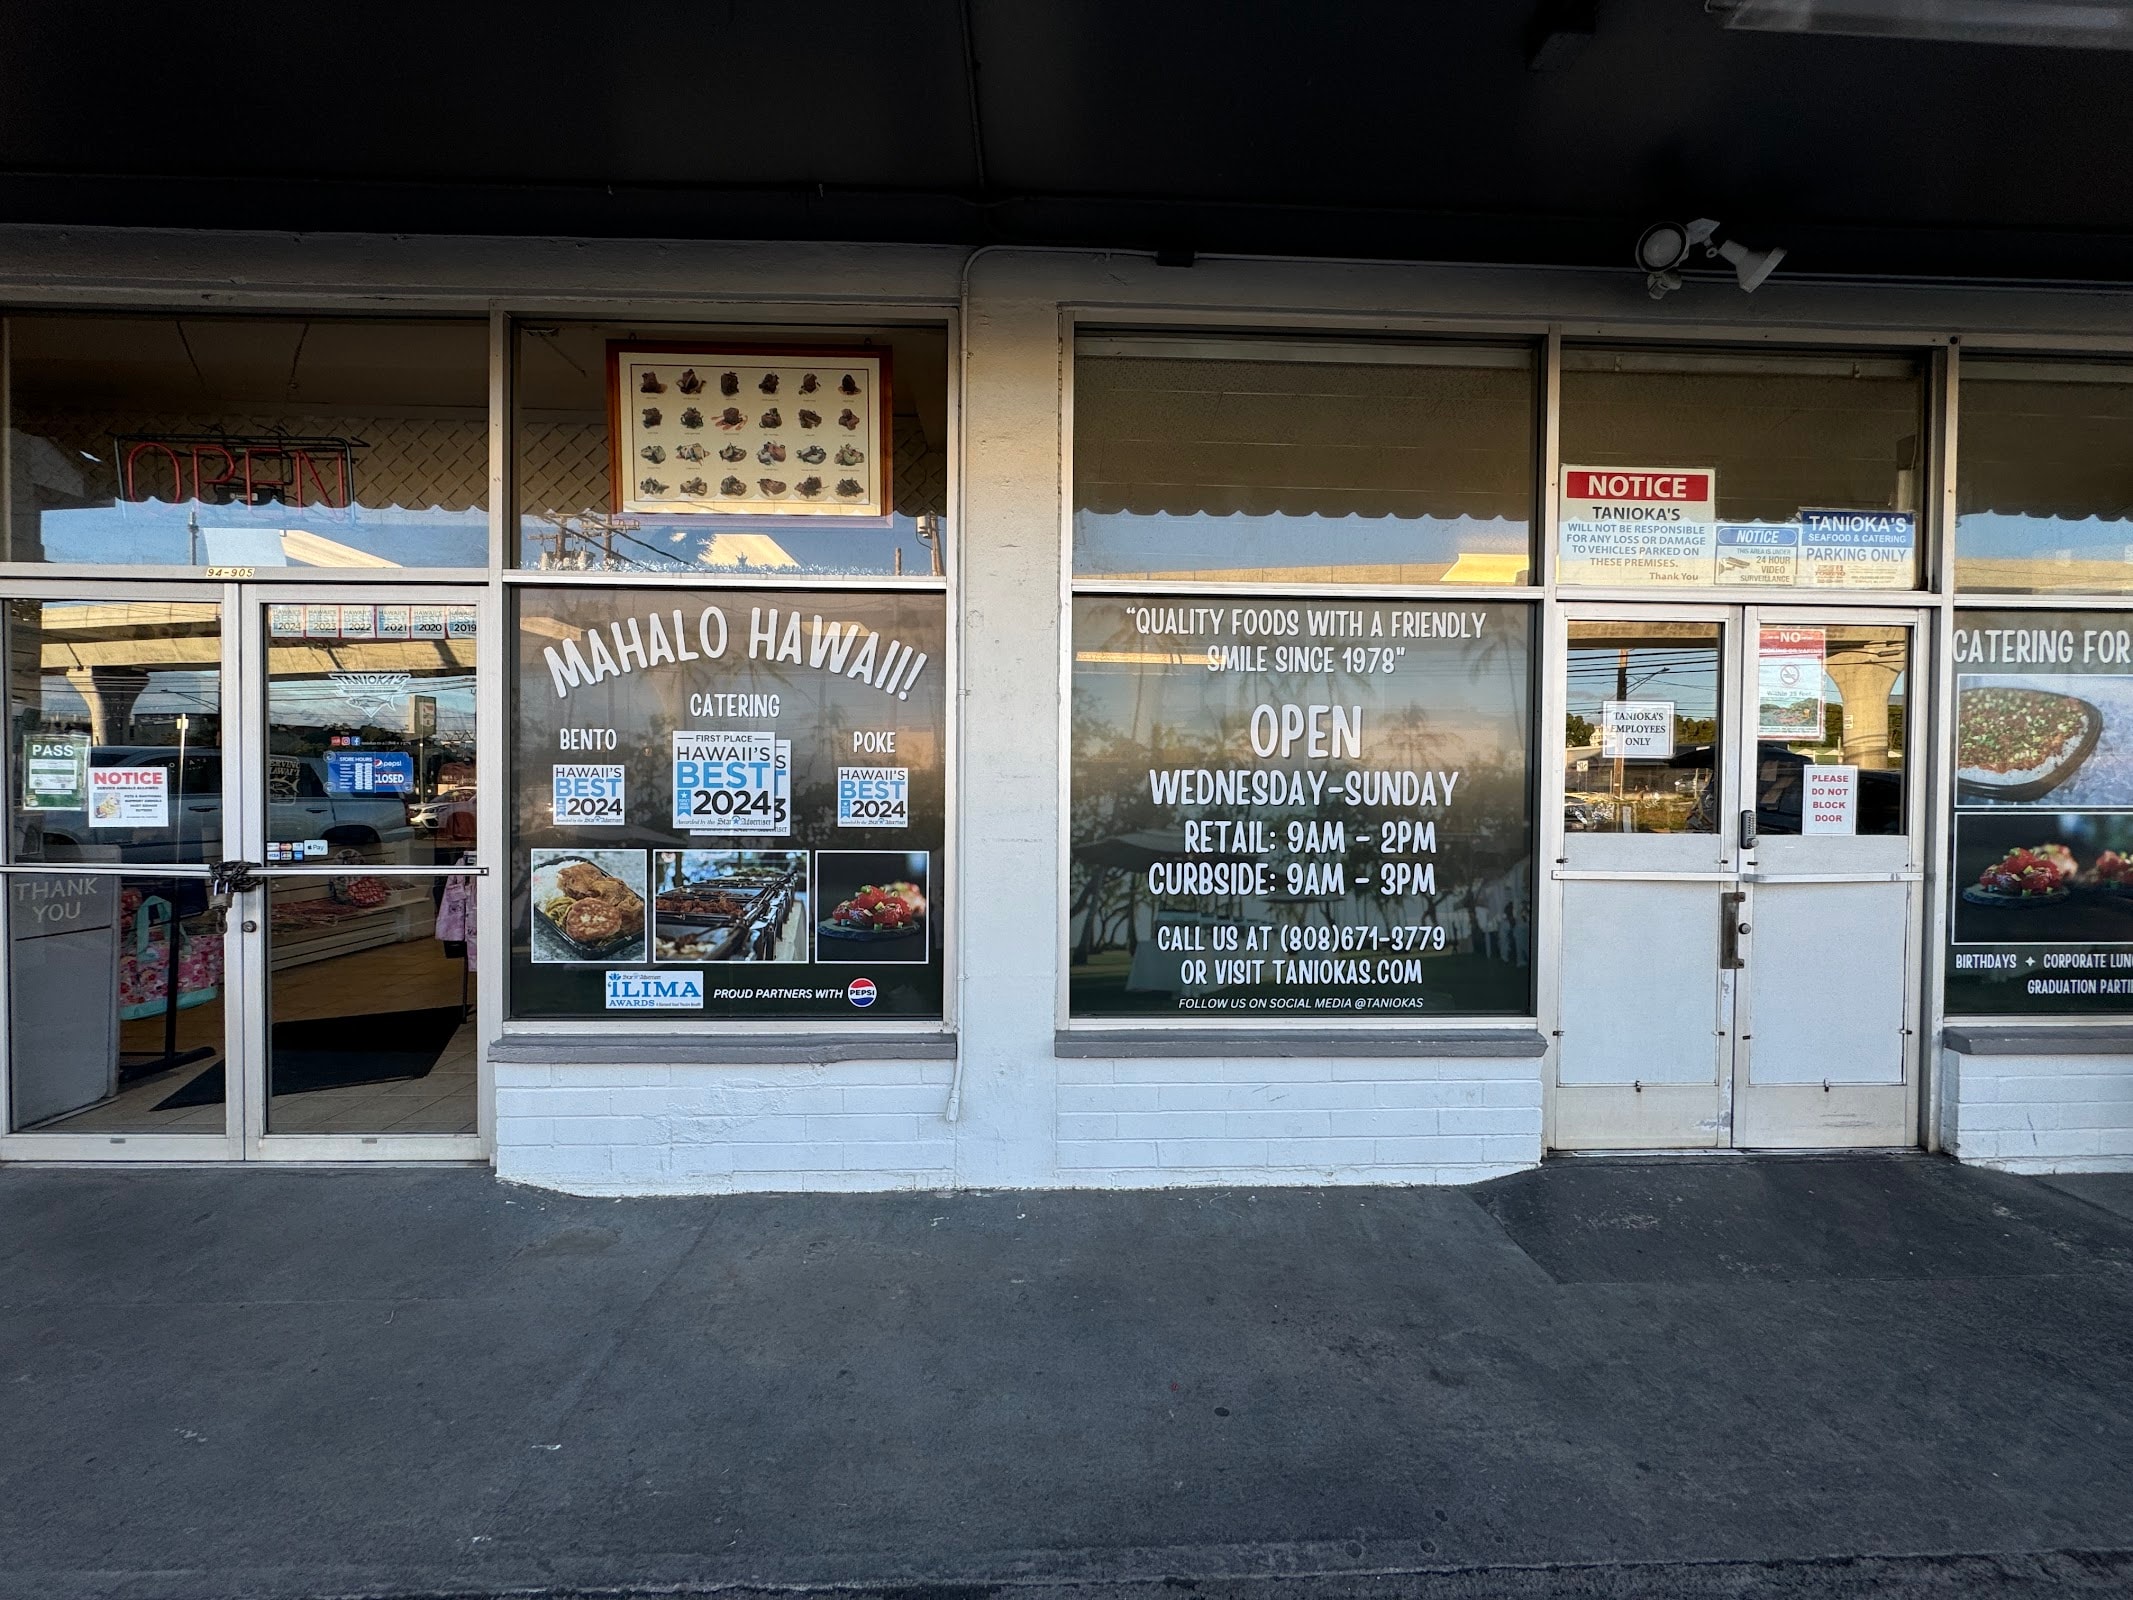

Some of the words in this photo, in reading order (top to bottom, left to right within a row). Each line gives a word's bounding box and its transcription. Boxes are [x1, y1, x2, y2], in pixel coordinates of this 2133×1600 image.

[127, 442, 345, 521] OPEN
[1588, 475, 1687, 498] NOTICE
[1592, 506, 1680, 521] TANIOKA'S
[1568, 523, 1592, 532] WILL
[1595, 524, 1616, 533] NOT
[1619, 525, 1632, 533] BE
[1634, 525, 1705, 534] RESPONSIBLE
[1809, 516, 1907, 533] TANIOKA'S
[1566, 534, 1587, 543] FOR
[1589, 535, 1611, 543] ANY
[1614, 536, 1639, 544] LOSS
[1642, 536, 1657, 545] OR
[1659, 537, 1706, 545] DAMAGE
[1736, 529, 1780, 544] NOTICE
[1808, 533, 1851, 542] SEAFOOD
[1862, 534, 1906, 543] CATERING
[1572, 545, 1586, 553] TO
[1588, 545, 1637, 555] VEHICLES
[1639, 547, 1680, 555] PARKED
[1683, 548, 1699, 556] ON
[1806, 548, 1866, 562] PARKING
[1871, 549, 1907, 563] ONLY
[1590, 558, 1622, 566] THESE
[1624, 558, 1679, 567] PREMISES.
[1756, 556, 1767, 564] 24
[1769, 557, 1791, 565] HOUR
[207, 568, 253, 577] 94-905
[1649, 572, 1679, 580] Thank
[1681, 573, 1699, 581] You
[1761, 566, 1786, 574] VIDEO
[1740, 575, 1790, 583] SURVEILLANCE
[313, 623, 337, 631] 2023
[349, 623, 372, 631] 2022
[1231, 608, 1299, 637] FOODS
[1307, 609, 1363, 637] WITH
[1370, 610, 1384, 637] A
[1391, 611, 1487, 639] FRIENDLY
[1780, 631, 1800, 643] NO
[1952, 629, 2074, 663] CATERING
[2083, 630, 2131, 664] FOR
[543, 607, 728, 698] MAHALO
[748, 607, 928, 701] HAWAII!
[1207, 646, 1268, 672] SMILE
[1275, 647, 1335, 673] SINCE
[332, 675, 409, 685] TANIOKA'S
[690, 693, 781, 718] CATERING
[1615, 712, 1664, 721] TANIOKA'S
[1250, 703, 1362, 759] OPEN
[1610, 725, 1666, 734] EMPLOYEES
[560, 728, 617, 751] BENTO
[696, 735, 721, 743] FIRST
[724, 735, 753, 743] PLACE
[853, 731, 896, 754] POKE
[1625, 737, 1651, 746] ONLY
[32, 744, 74, 757] PASS
[677, 746, 770, 761] HAWAII'S
[383, 760, 402, 768] pepsi
[93, 772, 163, 785] NOTICE
[375, 774, 405, 784] CLOSED
[556, 767, 622, 778] HAWAII'S
[677, 762, 771, 789] BEST
[840, 769, 905, 781] HAWAII'S
[1812, 774, 1849, 783] PLEASE
[556, 778, 622, 797] BEST
[840, 781, 905, 800] BEST
[1149, 769, 1459, 807] WEDNESDAY-SUNDAY
[1811, 788, 1824, 796] DO
[1827, 788, 1849, 796] NOT
[567, 798, 623, 816] 2024
[693, 790, 771, 815] 2024
[851, 800, 906, 818] 2024
[1813, 801, 1846, 810] BLOCK
[1815, 814, 1842, 823] DOOR
[1184, 820, 1276, 854] RETAIL:
[1287, 821, 1346, 854] 9AM
[1381, 821, 1437, 854] 2PM
[312, 844, 325, 852] Pay
[1148, 862, 1276, 896] CURBSIDE:
[1287, 863, 1346, 896] 9AM
[1380, 863, 1436, 896] 3PM
[14, 877, 97, 901] THANK
[32, 902, 81, 923] YOU
[1157, 926, 1205, 951] CALL
[1212, 926, 1238, 951] US
[1246, 926, 1273, 951] AT
[1280, 924, 1446, 952] (808)671-3779
[1956, 954, 2017, 969] BIRTHDAYS
[2043, 954, 2107, 969] CORPORATE
[1180, 960, 1208, 985] OR
[1214, 960, 1265, 985] VISIT
[1272, 959, 1423, 985] TANIOKAS.COM
[2028, 979, 2097, 994] GRADUATION
[713, 989, 753, 999] PROUD
[757, 989, 813, 999] PARTNERS
[815, 989, 844, 999] WITH
[609, 999, 655, 1007] AWARDS
[1178, 998, 1228, 1009] FOLLOW
[1230, 998, 1246, 1009] US
[1249, 998, 1266, 1009] ON
[1268, 998, 1312, 1009] SOCIAL
[1314, 998, 1352, 1009] MEDIA
[1355, 997, 1424, 1010] @TANIOKAS
